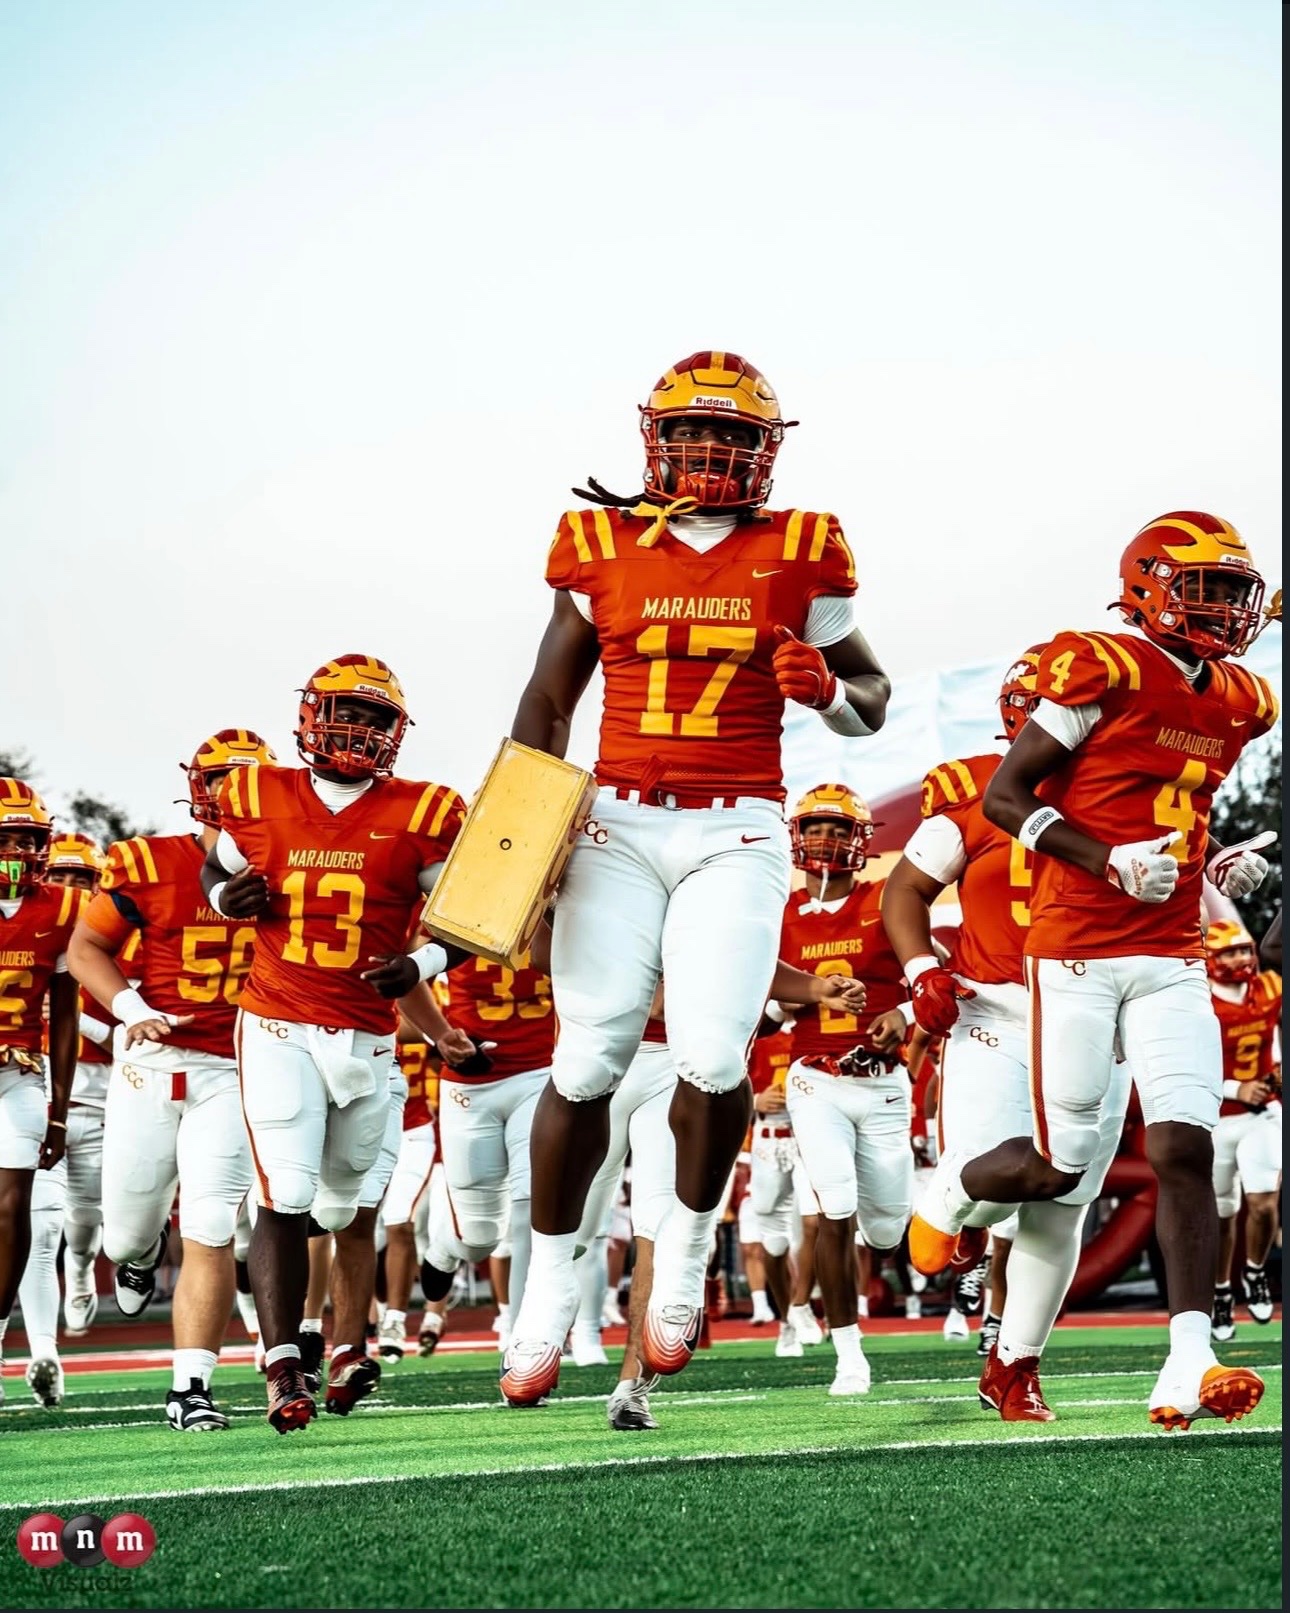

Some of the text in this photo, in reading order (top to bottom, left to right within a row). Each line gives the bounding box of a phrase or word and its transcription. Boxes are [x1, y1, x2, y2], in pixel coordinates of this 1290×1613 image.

[696, 397, 732, 408] Riddell
[641, 597, 752, 621] MARAUDERS
[636, 624, 758, 737] 17
[1049, 650, 1077, 695] 4
[1155, 726, 1225, 759] MARAUDERS
[1153, 758, 1207, 864] 4
[287, 848, 365, 870] MARAUDERS
[281, 870, 366, 969] 13
[801, 938, 863, 961] MARAUDERS
[969, 1026, 999, 1048] CCC
[122, 1064, 144, 1090] CCC
[791, 1075, 814, 1096] CCC
